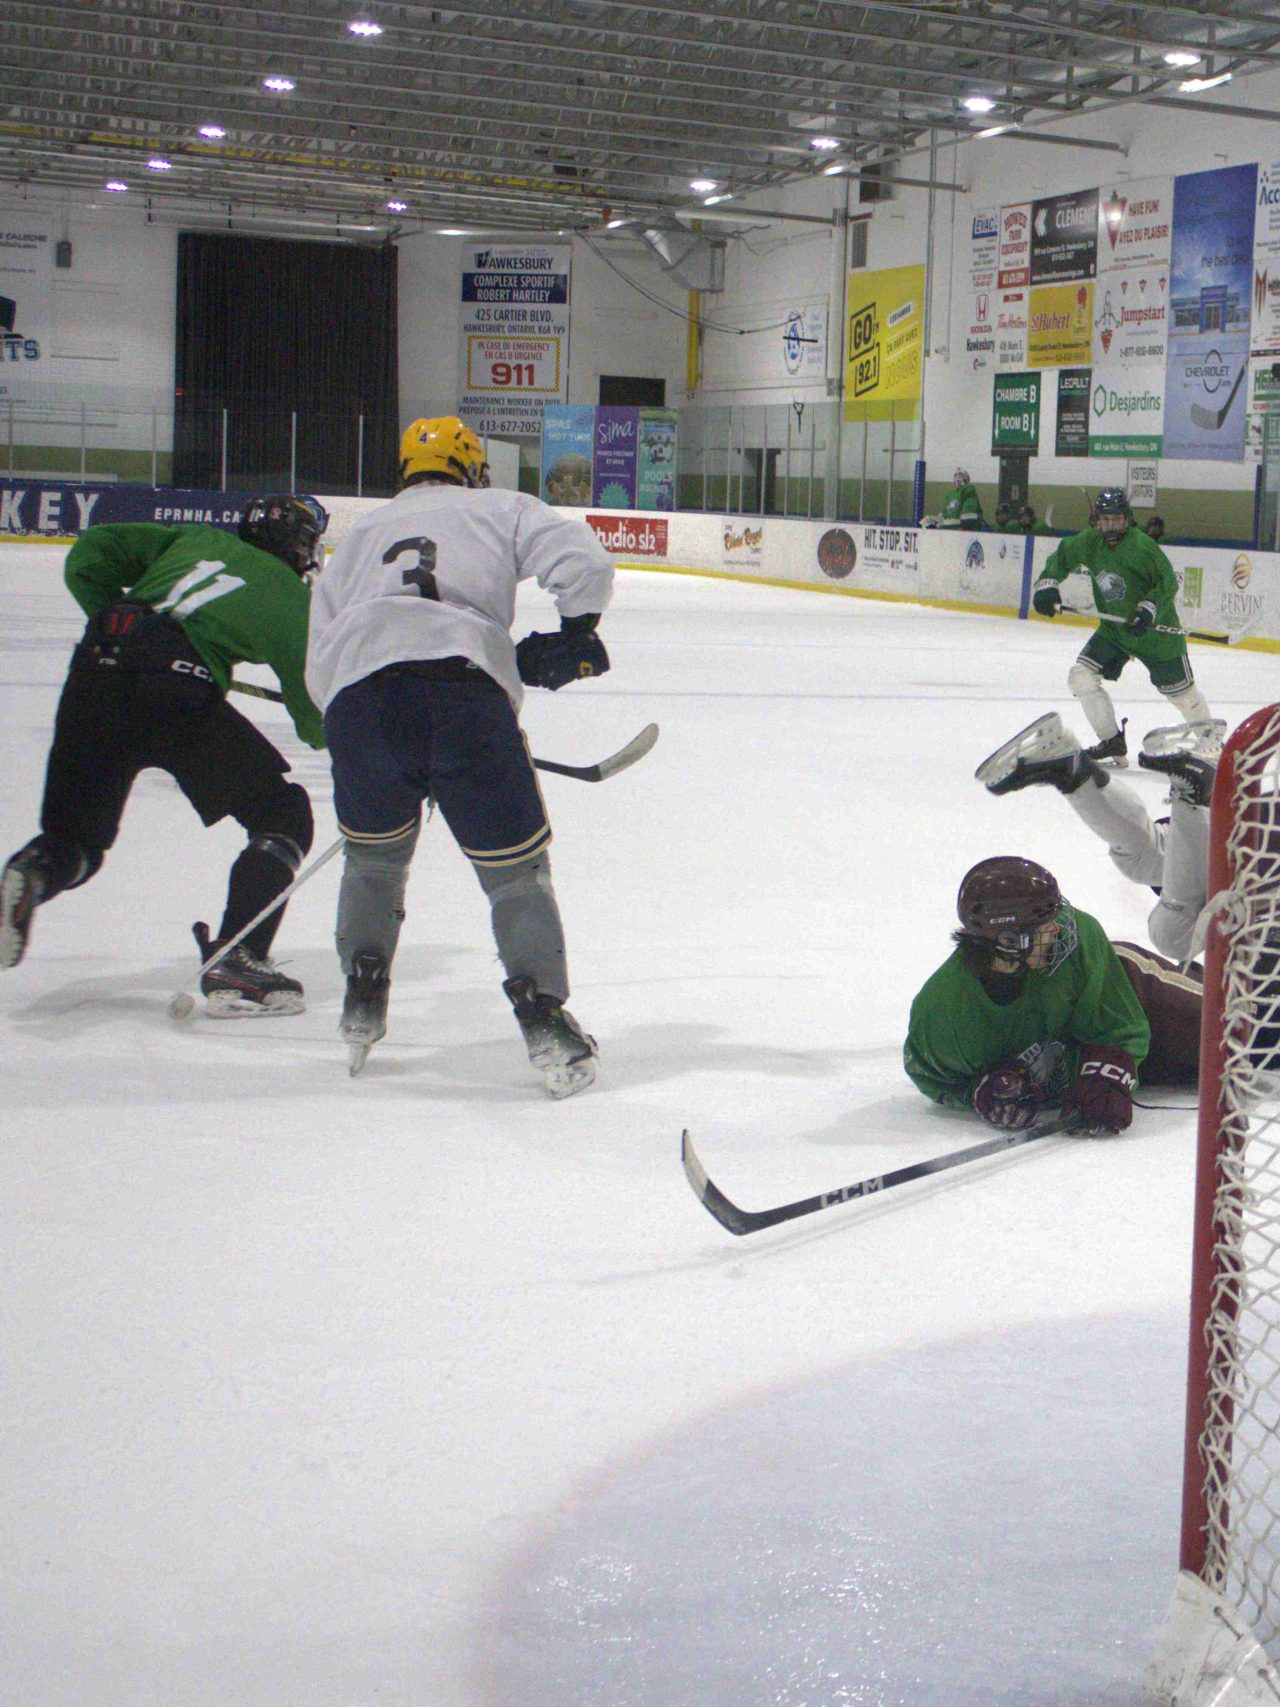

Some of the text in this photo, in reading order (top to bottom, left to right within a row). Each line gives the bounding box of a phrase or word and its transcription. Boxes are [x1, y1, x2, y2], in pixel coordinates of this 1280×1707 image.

[1129, 203, 1143, 216] HAVE
[1119, 229, 1133, 244] AYEZ
[1134, 228, 1143, 241] DU
[474, 275, 555, 289] COMPLEXE SPORTIF
[477, 289, 550, 302] ROBERT HARTLEY
[475, 309, 491, 321] 425
[494, 310, 527, 322] CARTIER
[1120, 306, 1165, 326] Jumpstart
[853, 314, 872, 350] GO
[970, 325, 992, 334] HONDA
[478, 342, 485, 350] IN
[487, 342, 501, 350] CASE
[512, 343, 550, 351] EMERGENCY
[967, 339, 995, 353] Hawkesbury
[491, 363, 534, 386] 911
[858, 356, 876, 385] 92.1
[1185, 366, 1230, 378] CHEVROLET
[996, 384, 1036, 403] CHAMBRE B
[463, 396, 505, 405] MAINTENANCE
[507, 397, 532, 406] WORKER
[1109, 390, 1161, 416] Desjardins
[480, 421, 541, 433] 613-677-2052
[546, 419, 572, 430] SPAS
[1001, 414, 1029, 432] ROOM B
[419, 432, 427, 444] 4
[644, 471, 672, 481] POOLS
[154, 507, 241, 523] EPRMHA.CA
[864, 528, 918, 553] HIT. STOP. SIT.
[1155, 624, 1190, 636] CCM
[171, 660, 211, 680] CC
[990, 916, 1016, 925] CCM
[1080, 1061, 1136, 1090] CCM
[820, 1175, 884, 1209] CCM
